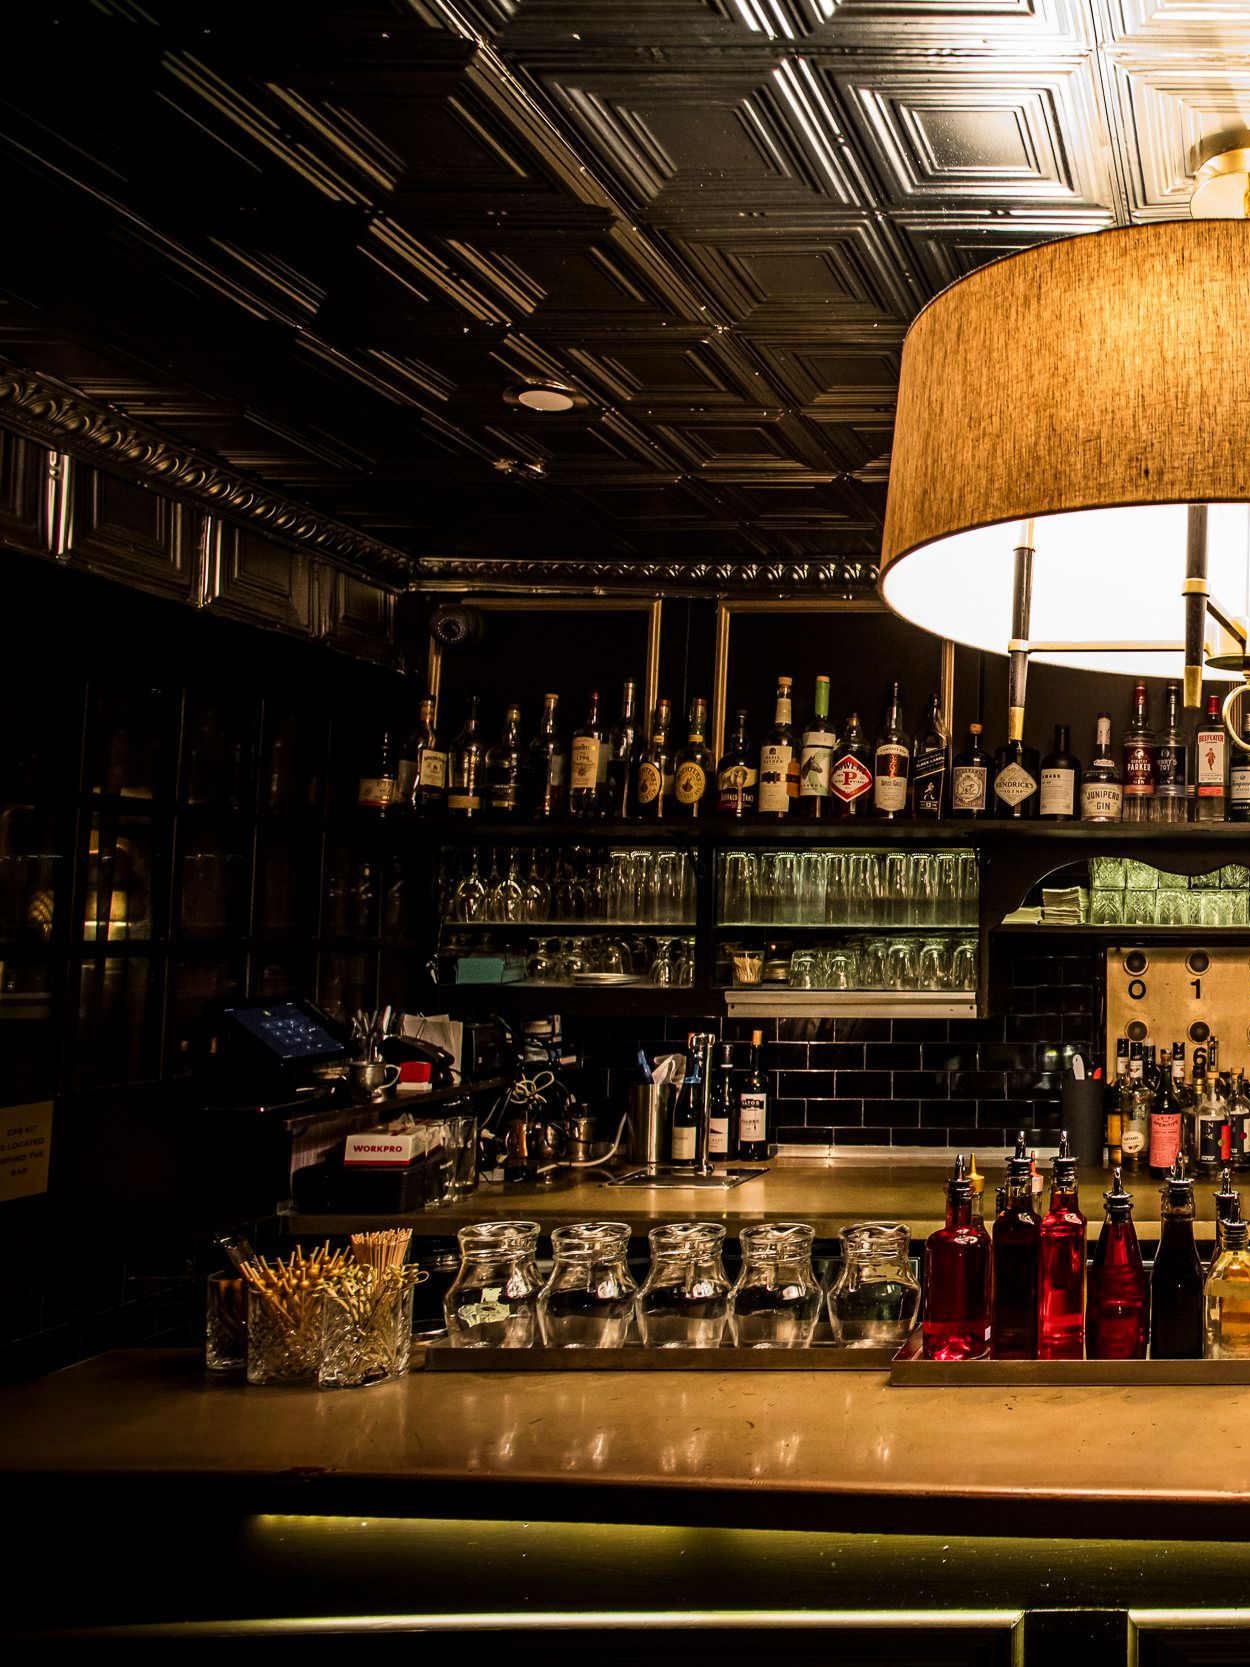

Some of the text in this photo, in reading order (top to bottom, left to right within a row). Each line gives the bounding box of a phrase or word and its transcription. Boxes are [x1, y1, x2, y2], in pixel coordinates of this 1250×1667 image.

[1127, 763, 1151, 771] PARKER
[842, 771, 857, 786] P
[1086, 790, 1120, 801] JUNIPERO
[1096, 802, 1111, 810] GIN
[1128, 979, 1146, 1000] 0
[1190, 979, 1201, 999] 1
[1193, 1047, 1207, 1066] 6
[7, 1137, 45, 1150] LOCATED
[28, 1150, 44, 1160] THE
